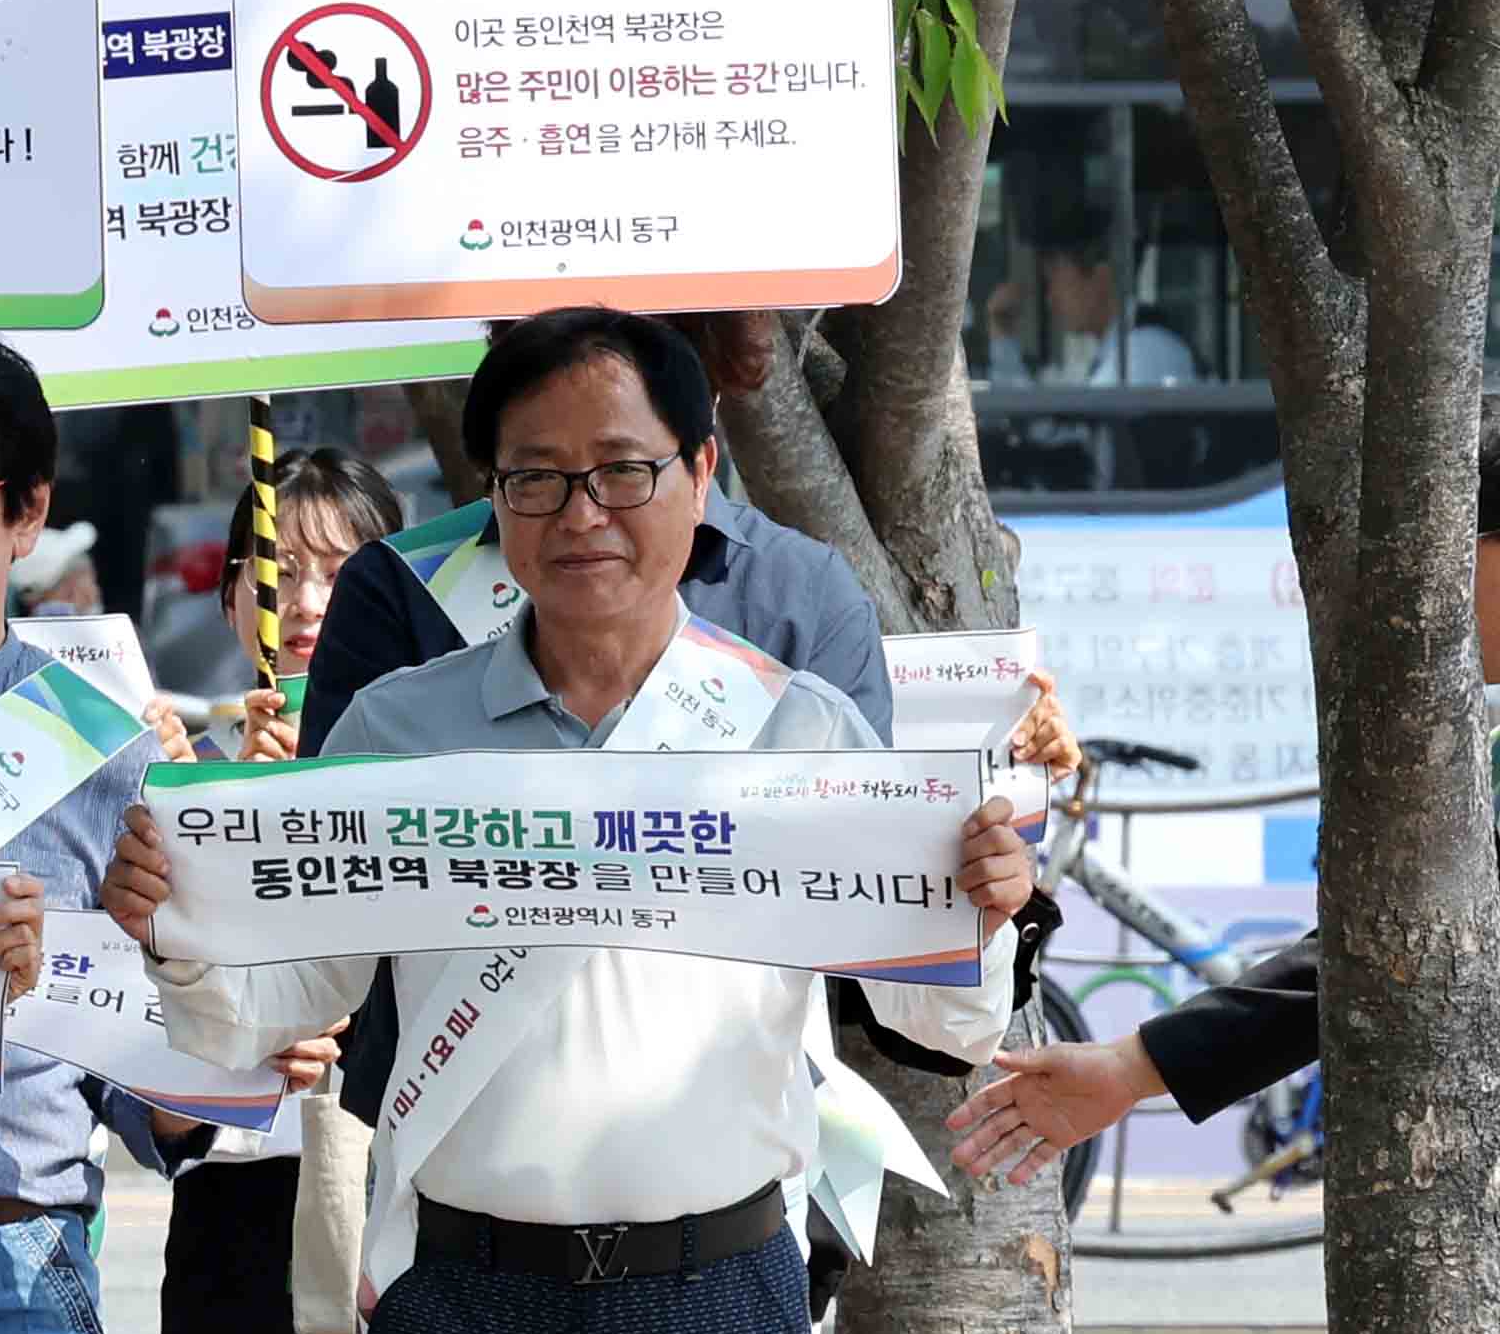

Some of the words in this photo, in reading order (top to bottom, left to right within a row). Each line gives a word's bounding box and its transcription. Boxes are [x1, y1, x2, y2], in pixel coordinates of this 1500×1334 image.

[142, 25, 225, 62] 북광장
[455, 18, 505, 48] 이곳
[513, 14, 615, 46] 동인천역
[623, 11, 725, 42] 북광장은
[457, 69, 508, 104] 많은
[518, 67, 598, 101] 주민이
[609, 64, 718, 98] 이용하는
[457, 125, 512, 160] 음주
[630, 119, 706, 153] 삼가해
[714, 118, 796, 151] 주세요.
[118, 140, 179, 178] 함께
[500, 217, 623, 250] 인천광역시
[630, 214, 680, 246] 동구
[177, 806, 262, 848] 우리
[283, 806, 367, 844] 함께
[386, 806, 574, 850] 건강하고
[593, 810, 737, 856] 깨끗한
[252, 857, 430, 901] 동인천역
[650, 861, 783, 899] 만들어
[801, 866, 955, 912] 갑시다!
[504, 903, 623, 928] 인천광역시
[631, 905, 677, 930] 동구
